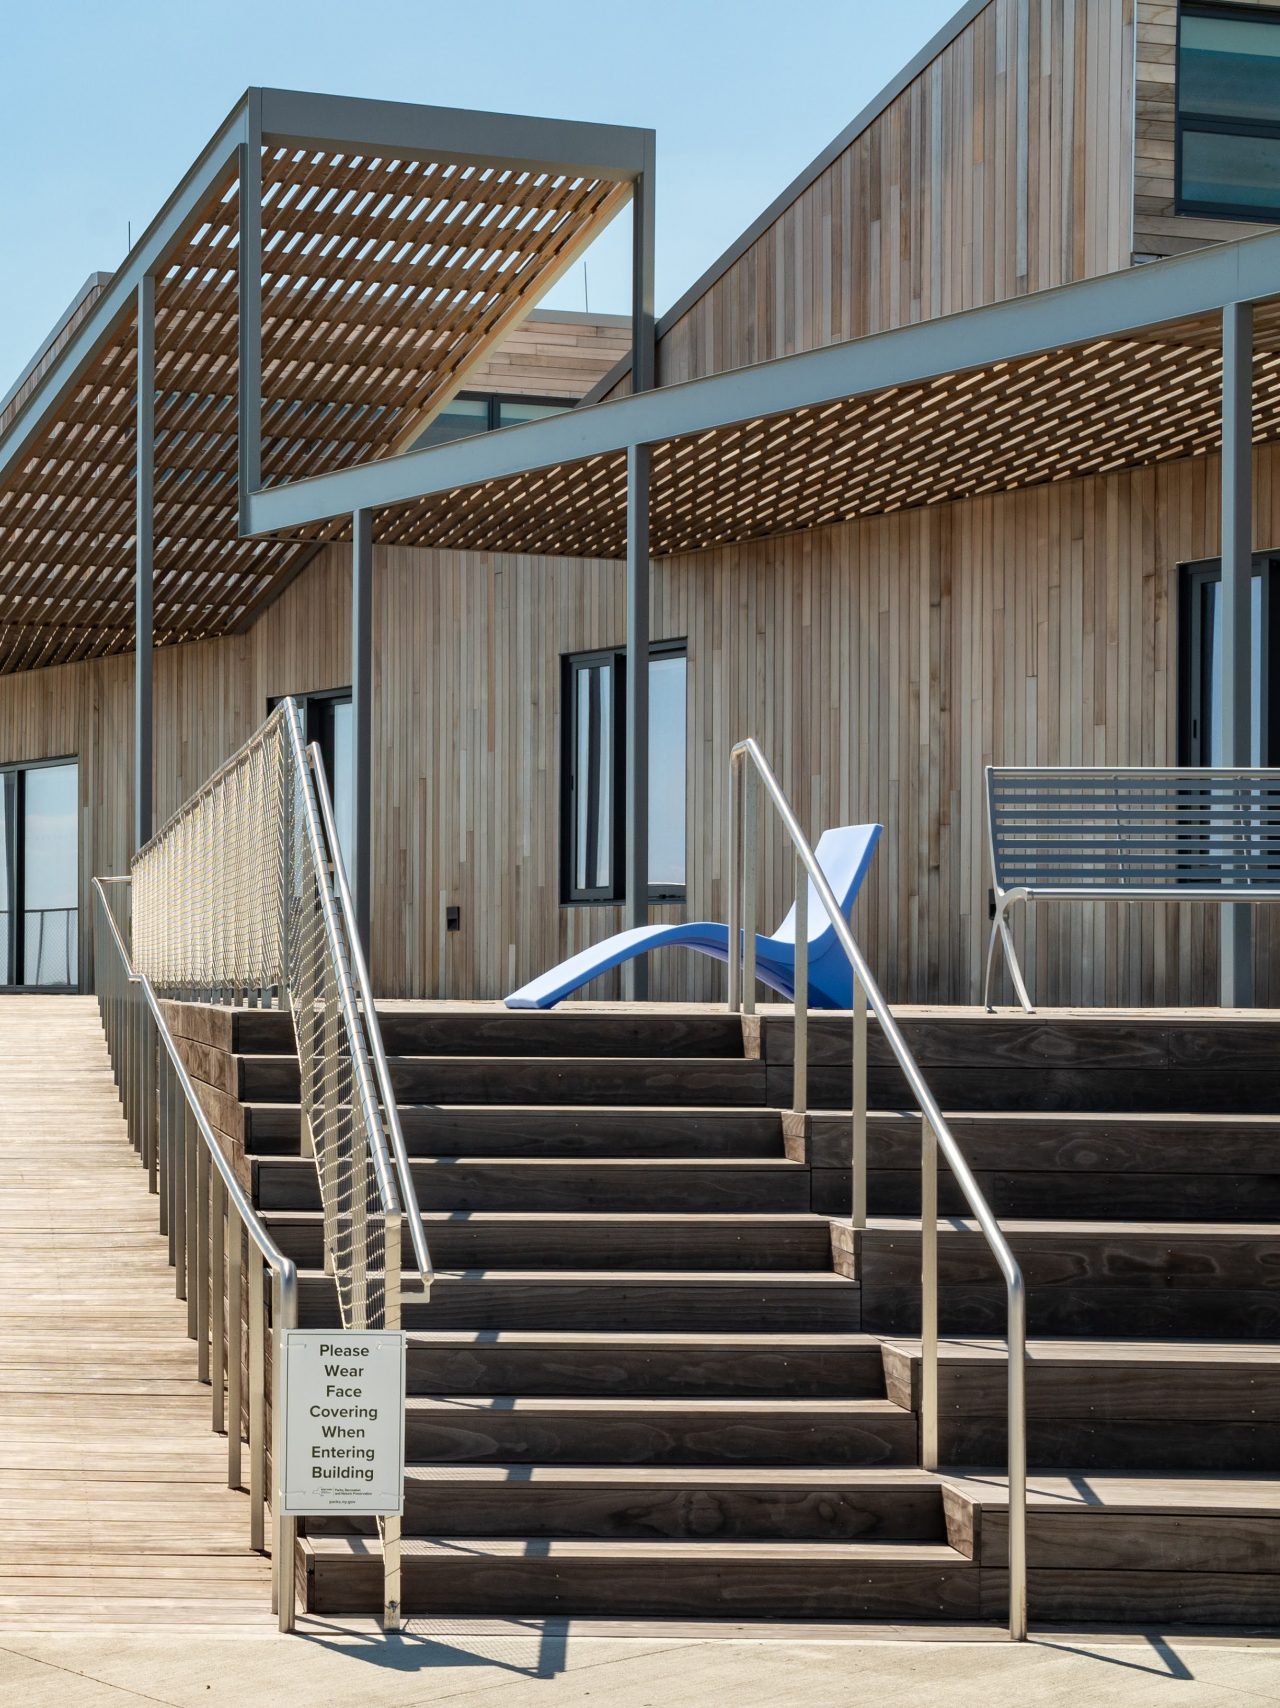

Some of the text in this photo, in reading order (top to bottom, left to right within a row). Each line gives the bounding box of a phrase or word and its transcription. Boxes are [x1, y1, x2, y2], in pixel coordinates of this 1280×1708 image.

[319, 1343, 370, 1357] Please
[324, 1364, 365, 1378] Wear
[326, 1384, 362, 1398] Face
[309, 1404, 378, 1421] Covering
[321, 1425, 365, 1439] When
[311, 1445, 375, 1462] Entering
[311, 1465, 374, 1482] Building
